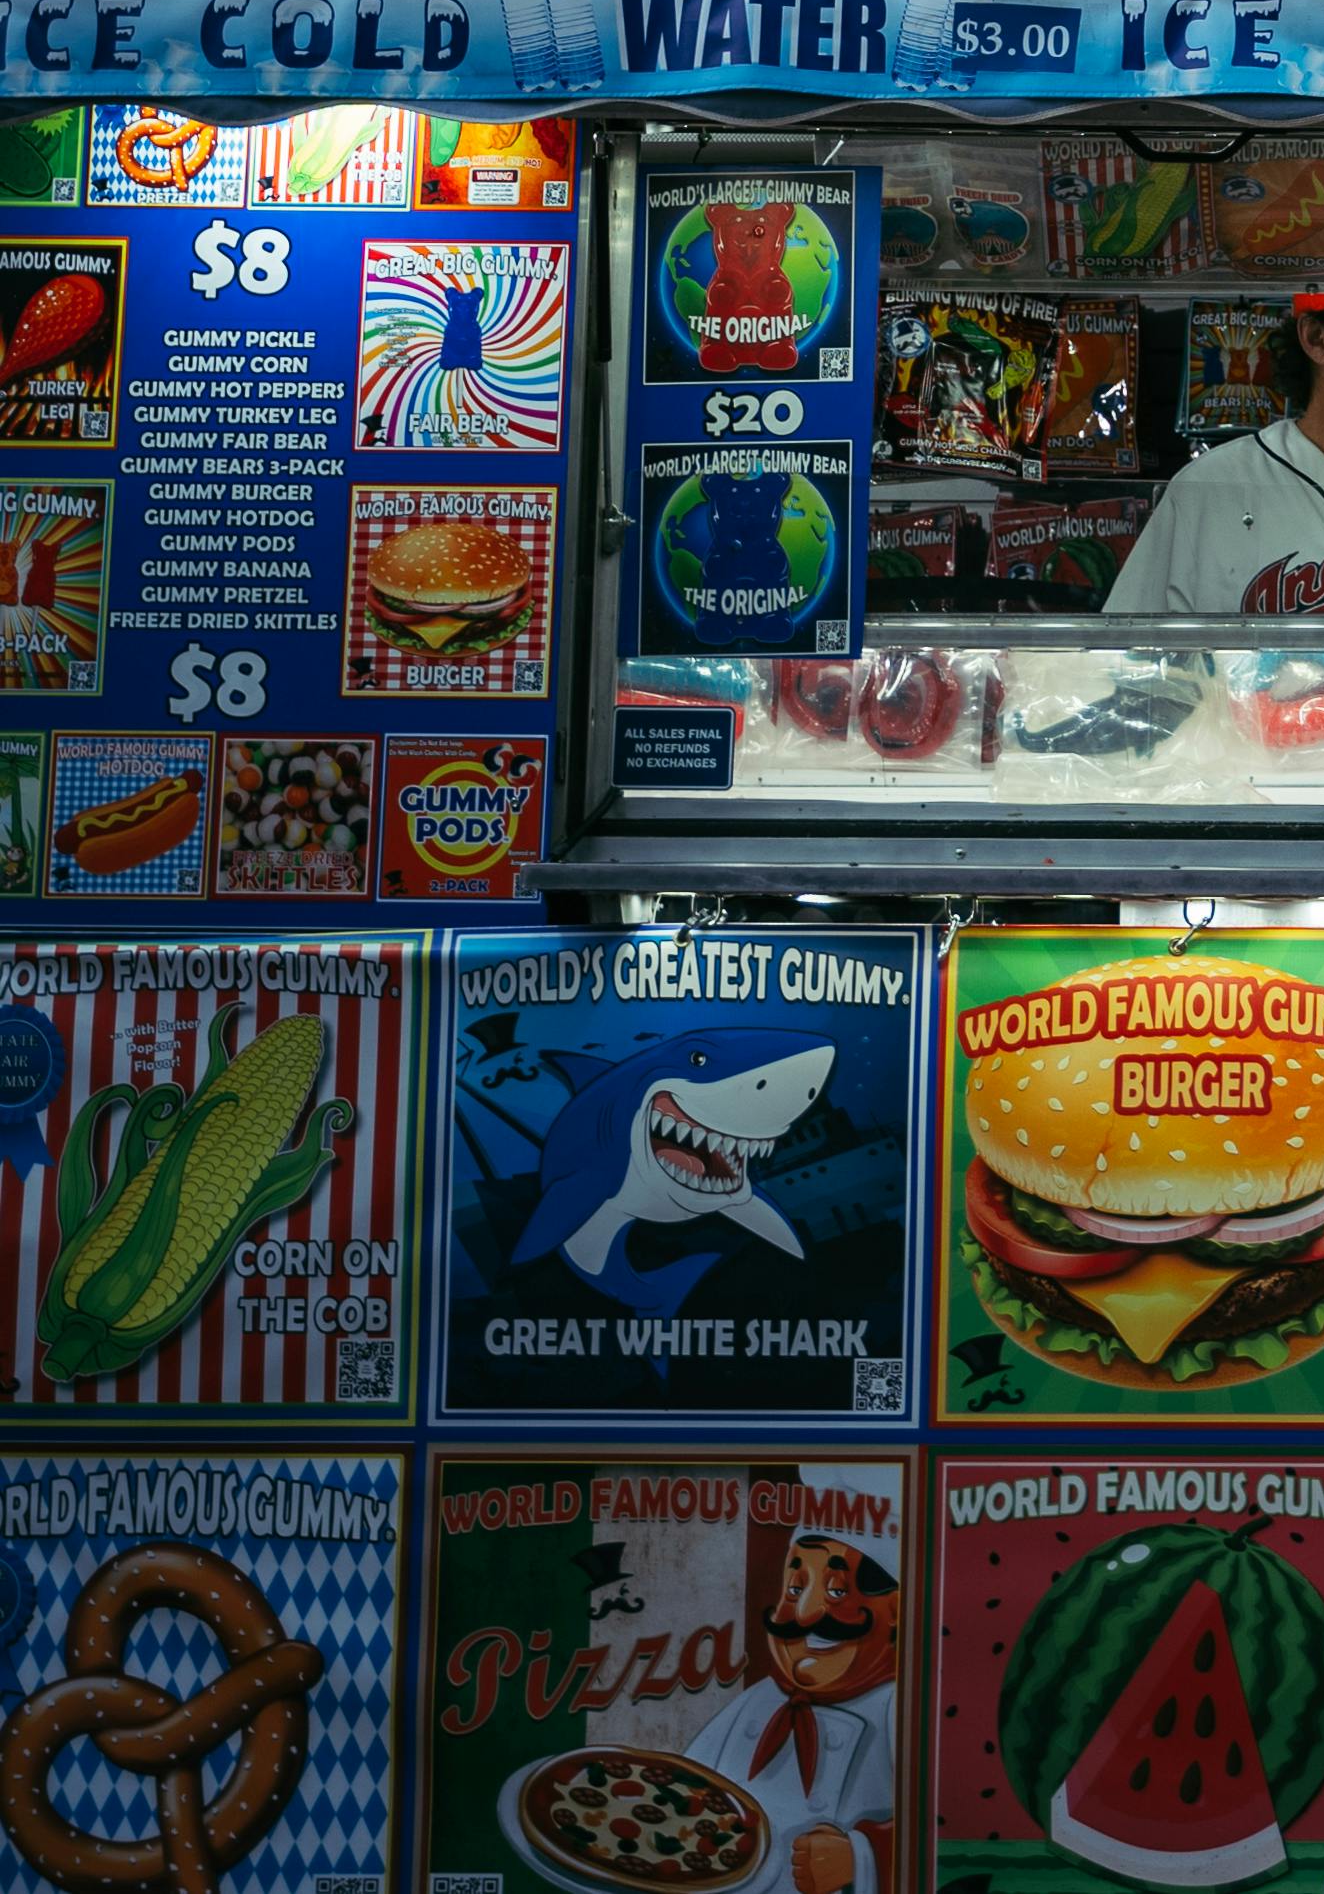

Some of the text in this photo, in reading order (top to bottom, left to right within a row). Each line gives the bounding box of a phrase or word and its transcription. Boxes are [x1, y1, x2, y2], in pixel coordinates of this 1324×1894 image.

[956, 19, 1070, 60] $3.00
[648, 178, 851, 209] WORLD'S LARGEST GUMMY BEAR
[192, 219, 292, 299] $8
[163, 329, 316, 348] GUMMY PICKLE
[688, 313, 812, 345] THE ORIGINAL
[168, 355, 308, 373] GUMMY CORN
[128, 380, 345, 399] GUMMY HOT PEPPERS
[134, 406, 337, 425] GUMMY TURKEY LEG
[705, 389, 804, 437] $20
[140, 431, 328, 450] GUMMY FAIR BEAR
[120, 457, 345, 476] GUMMY BEARS 3-PACK
[149, 483, 313, 501] GUMMY BURGER
[144, 508, 315, 527] GUMMY HOTDOG
[160, 534, 295, 552] GUMMY PODS
[141, 560, 312, 578] GUMMY BANANA
[141, 586, 309, 604] GUMMY PRETZEL
[109, 612, 337, 630] FREEZE DRIED SKITTLES
[169, 643, 268, 723] $8
[1121, 1063, 1266, 1111] BURGER
[234, 1240, 398, 1280] CORN ON
[239, 1296, 389, 1336] THE COB
[485, 1317, 868, 1358] GREAT WHITE SHARK
[440, 1615, 750, 1739] Pizza
